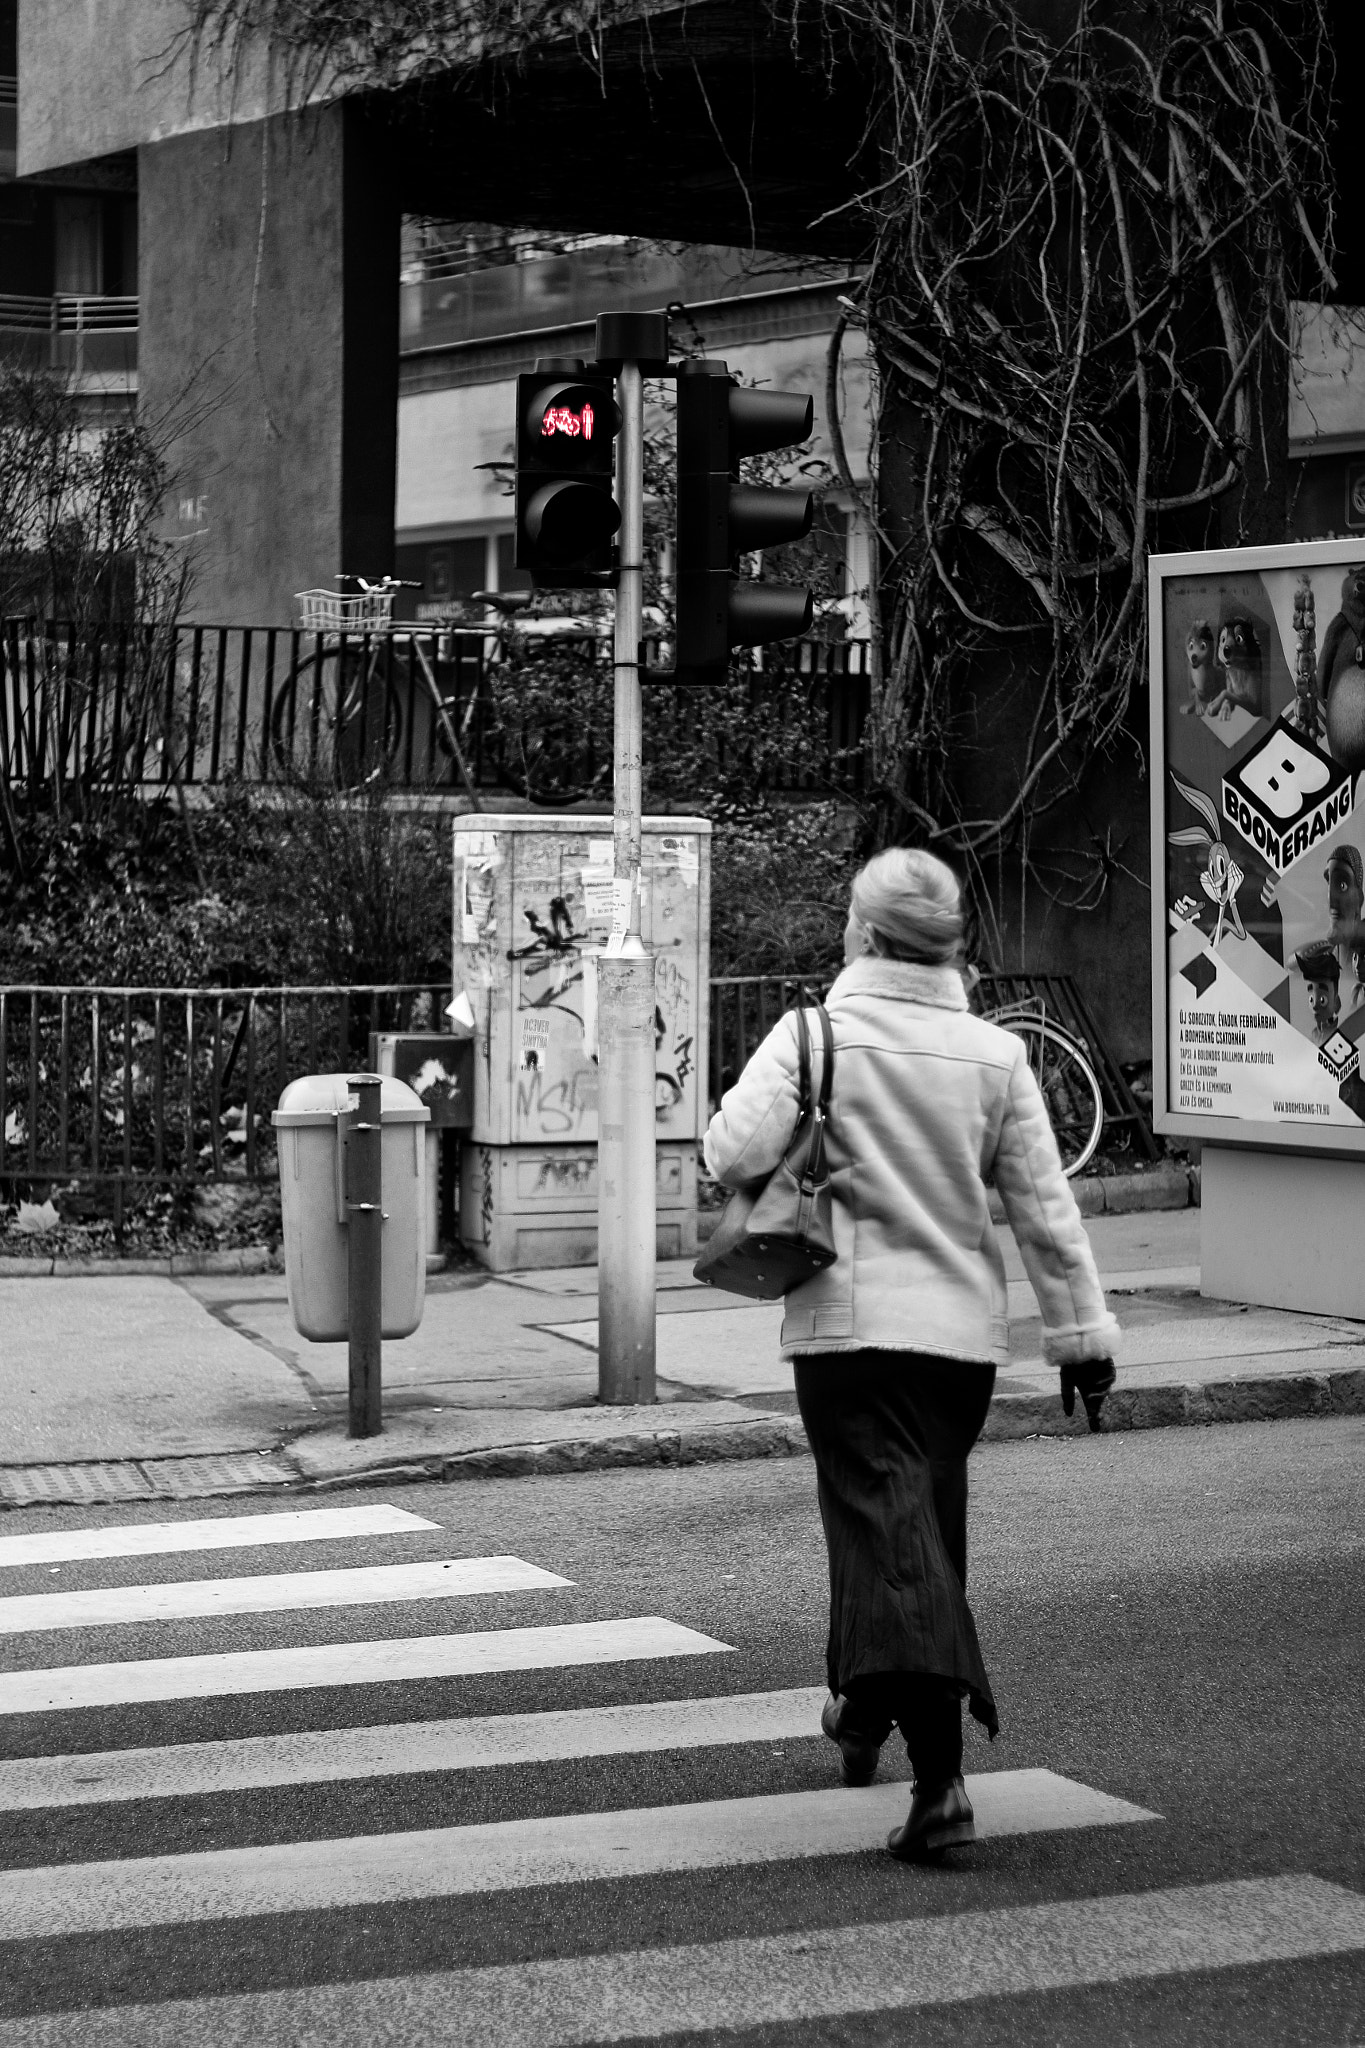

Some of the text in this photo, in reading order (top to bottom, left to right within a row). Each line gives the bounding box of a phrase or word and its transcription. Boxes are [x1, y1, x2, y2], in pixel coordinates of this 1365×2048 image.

[1239, 728, 1331, 819] B
[1224, 784, 1350, 869] BOOMERANG
[1179, 1009, 1187, 1024] ÚJ
[1218, 1011, 1238, 1027] ÉVADOK
[1239, 1013, 1277, 1029] FEBRUÁRBAN
[1185, 1030, 1214, 1044] BOOMERANG
[1186, 1062, 1192, 1075] ÉS
[1317, 1051, 1359, 1082] BOOMERANG
[1195, 1078, 1201, 1092] ÉS
[1191, 1094, 1197, 1107] ÉS
